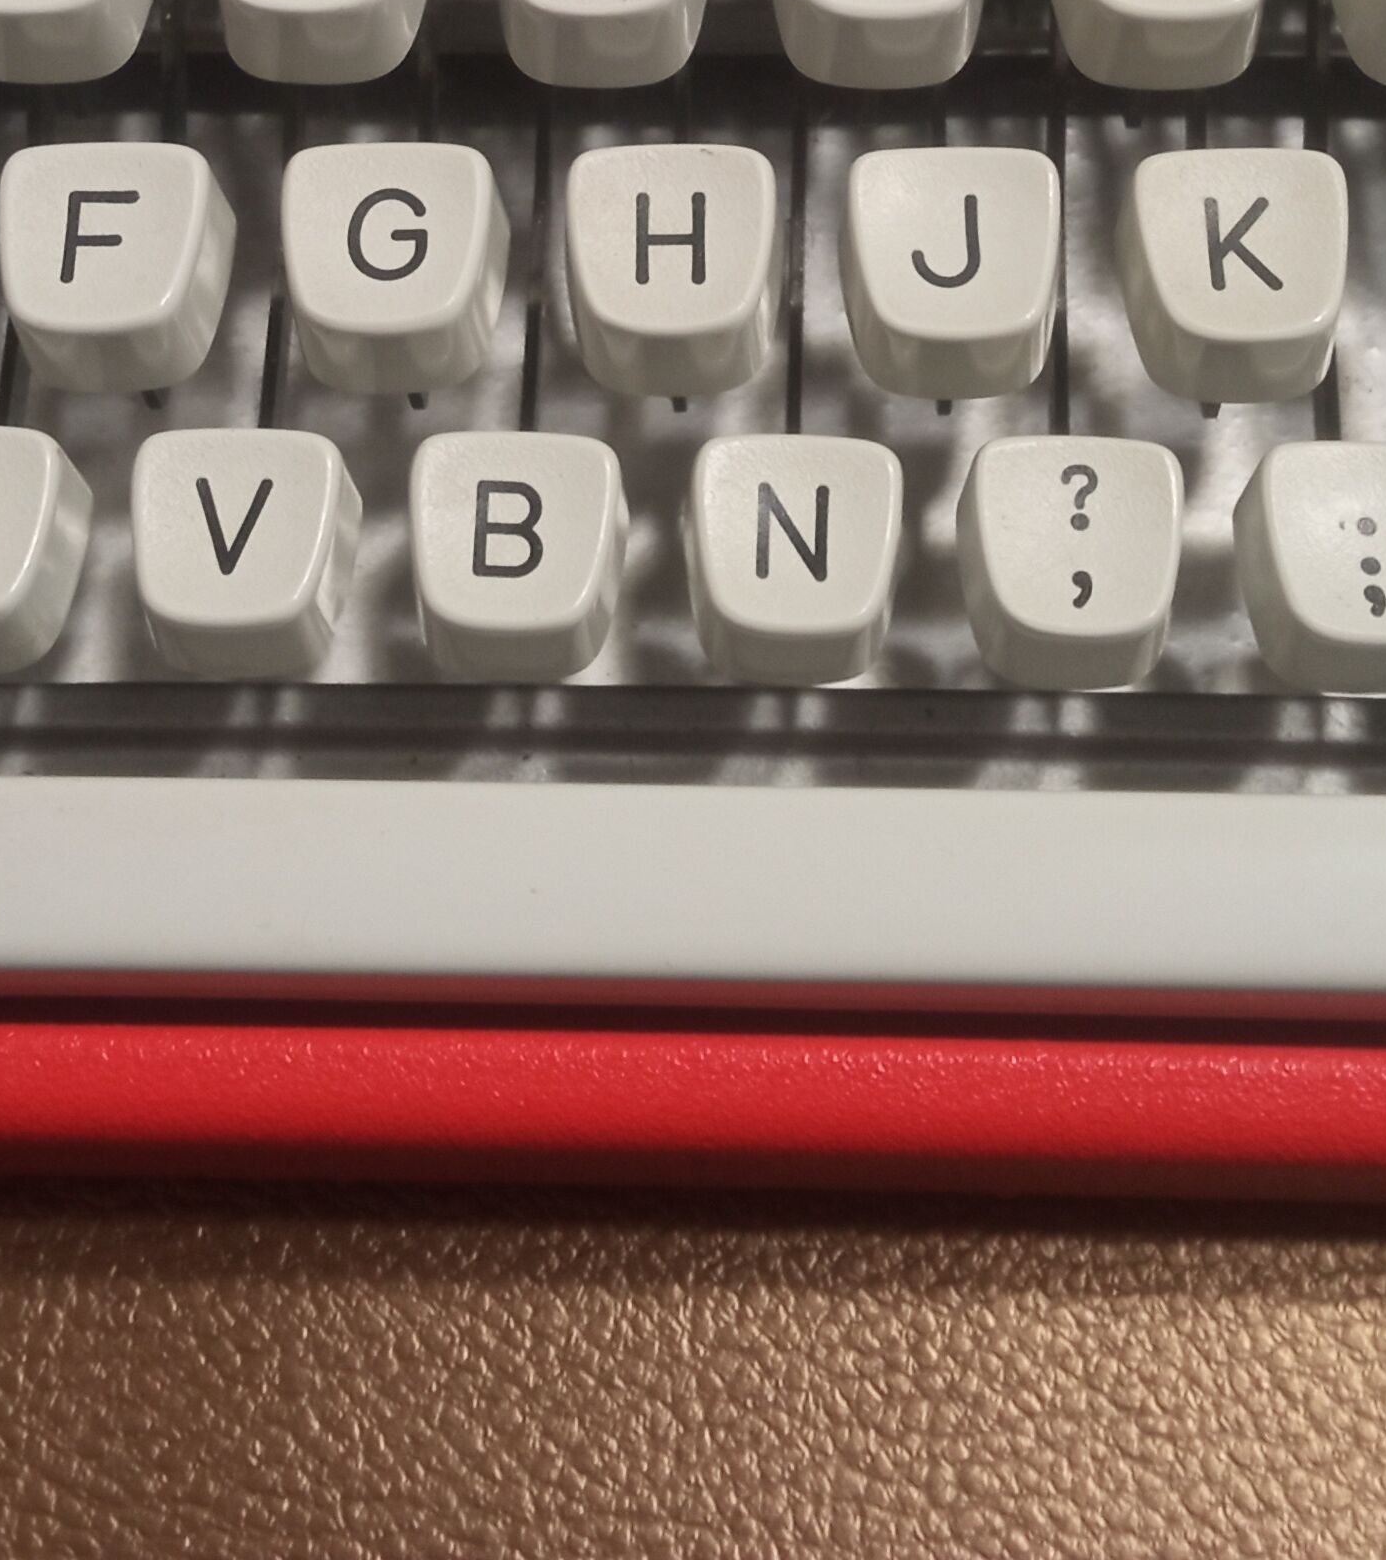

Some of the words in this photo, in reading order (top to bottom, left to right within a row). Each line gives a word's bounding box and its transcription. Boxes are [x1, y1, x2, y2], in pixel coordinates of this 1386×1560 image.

[58, 189, 142, 285] F
[345, 186, 430, 283] G
[634, 190, 708, 287] H
[910, 193, 982, 290] J
[1202, 195, 1285, 293] K
[194, 476, 275, 577] V
[471, 478, 545, 580] B
[754, 481, 831, 584] N
[1059, 463, 1100, 533] ?
